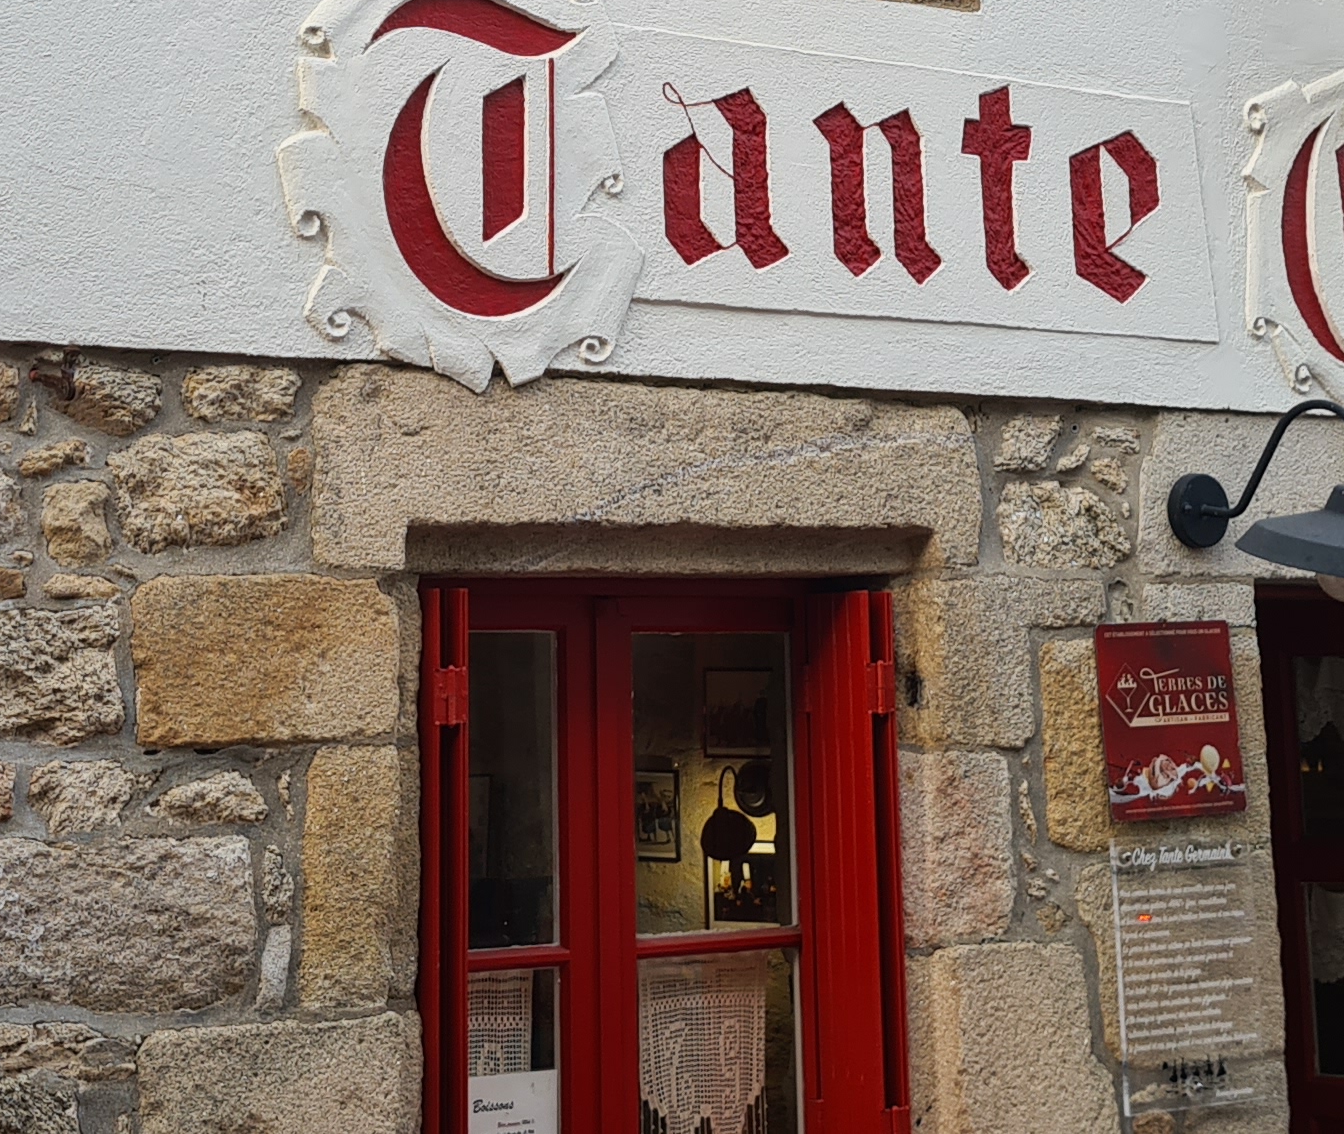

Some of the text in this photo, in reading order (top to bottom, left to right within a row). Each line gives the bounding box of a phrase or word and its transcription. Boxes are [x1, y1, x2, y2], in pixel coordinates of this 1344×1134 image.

[1140, 668, 1227, 693] TERRES DE
[1149, 691, 1229, 717] GLACES
[1132, 847, 1156, 871] Chez
[1158, 846, 1183, 864] Tante
[473, 1099, 514, 1113] Boissons
